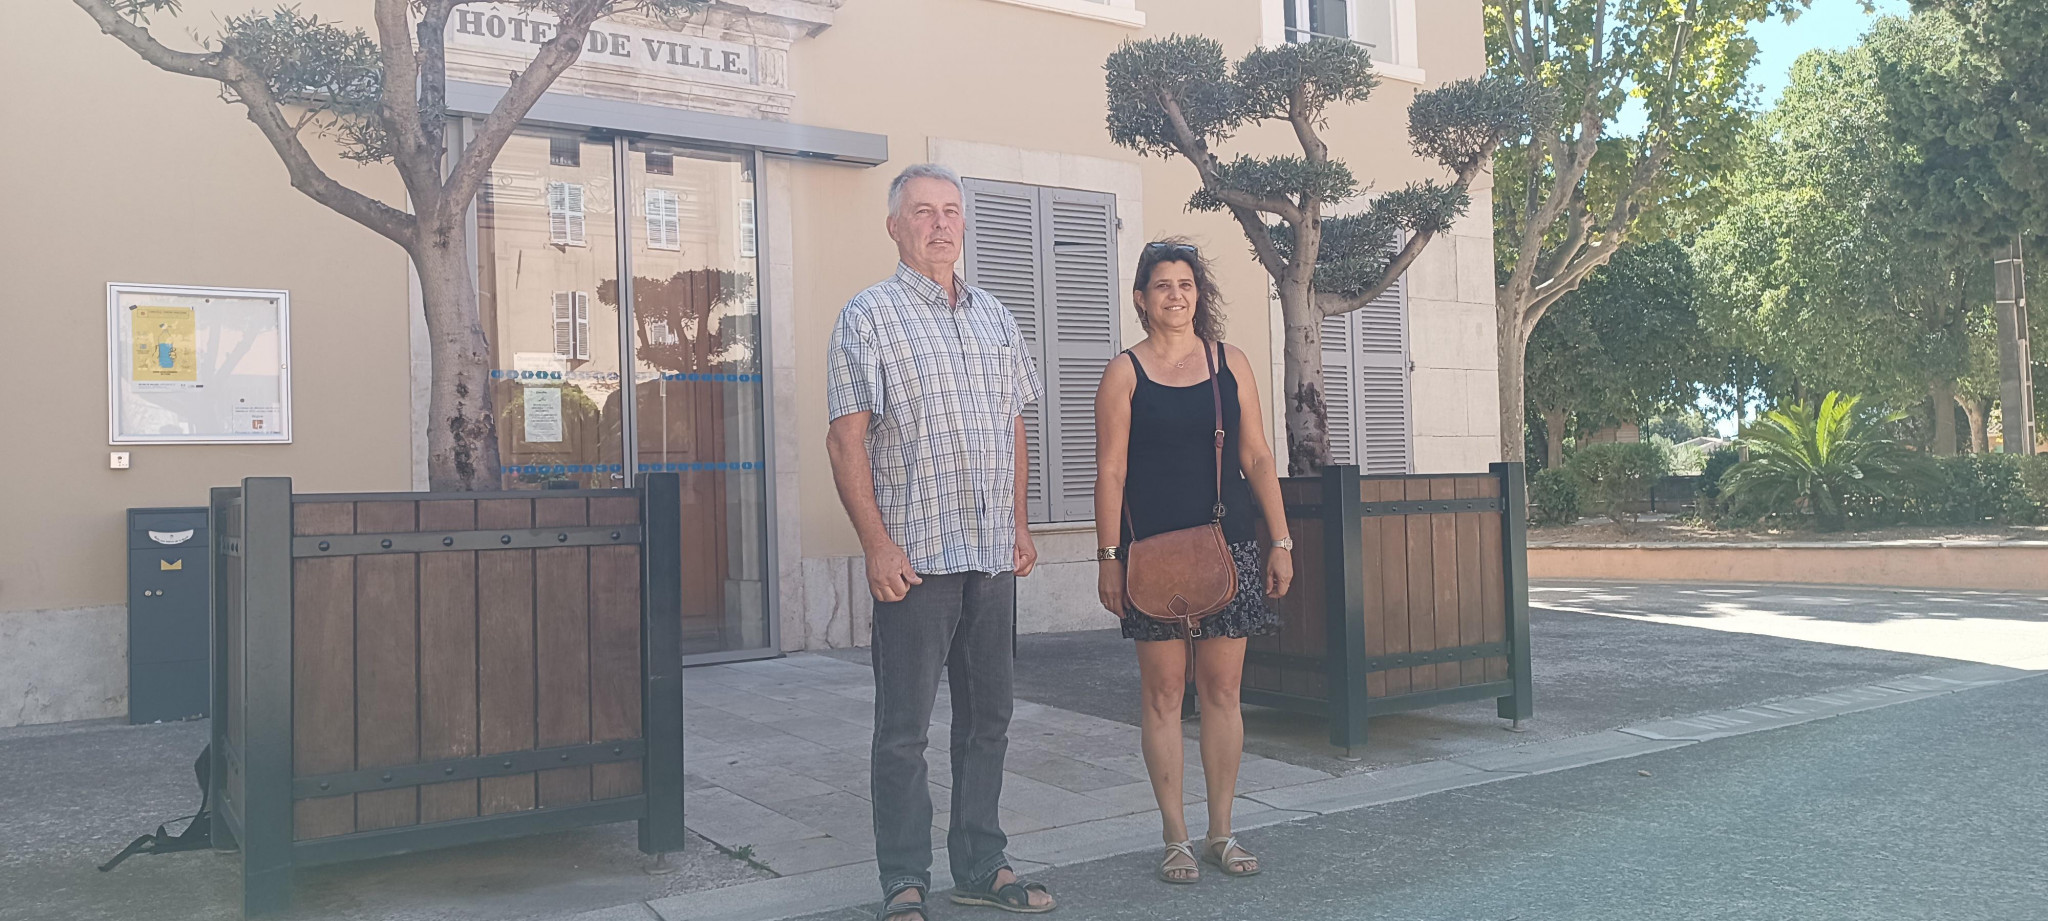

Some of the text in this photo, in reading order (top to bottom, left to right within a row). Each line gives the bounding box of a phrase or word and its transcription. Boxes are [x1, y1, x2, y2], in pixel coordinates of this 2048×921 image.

[456, 6, 748, 76] HÔTE DE VILLE.
